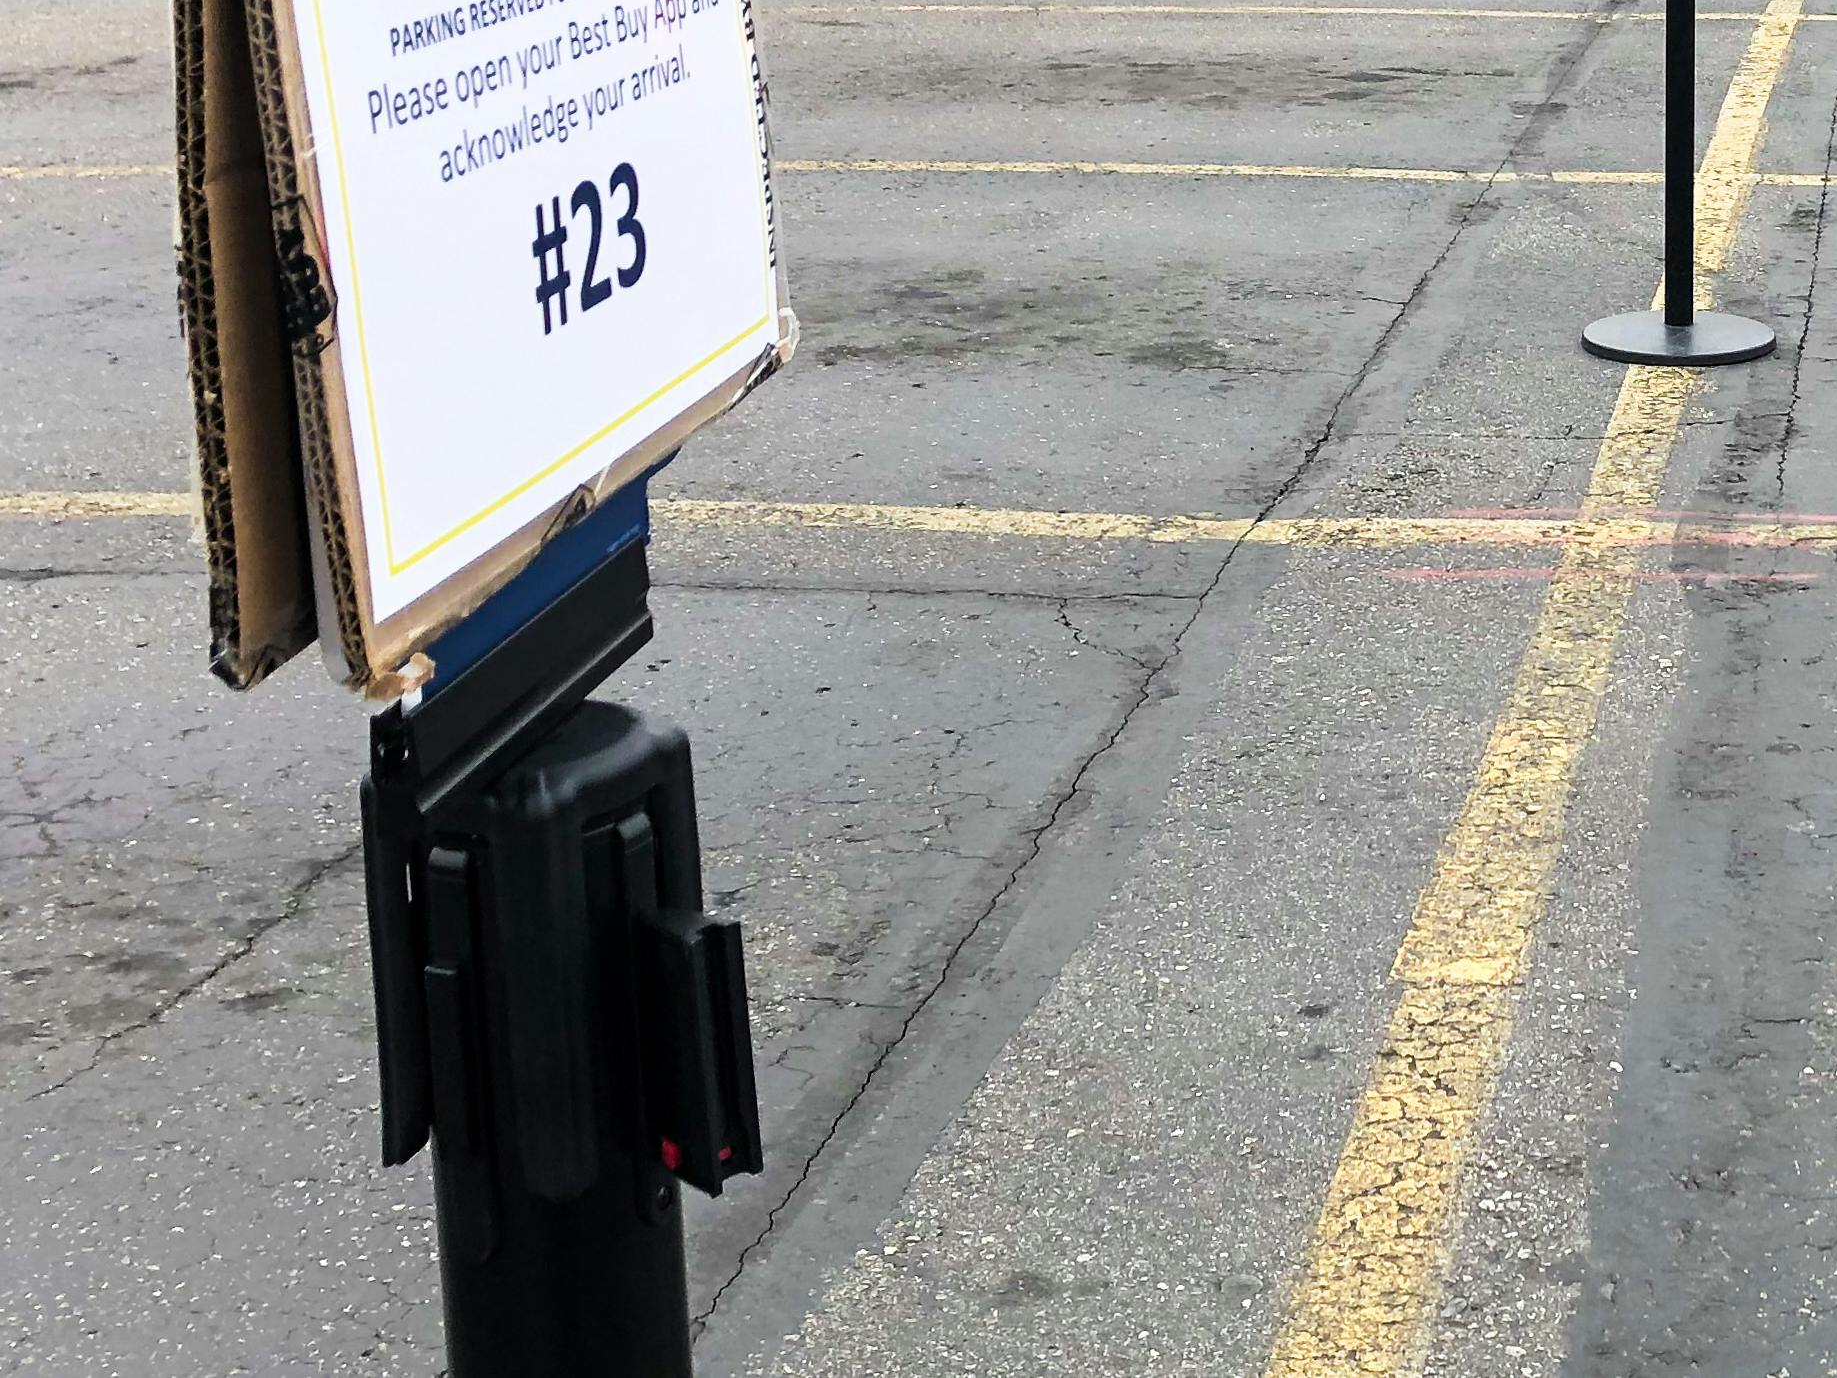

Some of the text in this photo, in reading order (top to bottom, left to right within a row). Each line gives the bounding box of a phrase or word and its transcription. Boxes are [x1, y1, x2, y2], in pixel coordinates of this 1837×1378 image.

[368, 78, 449, 134] Please
[455, 55, 513, 109] open
[516, 36, 563, 90] your
[568, 14, 612, 60] Best
[615, 4, 648, 43] Buy
[390, 7, 466, 57] PARKING
[440, 43, 692, 183] acknowledge your arrival.
[532, 162, 647, 336] #23
